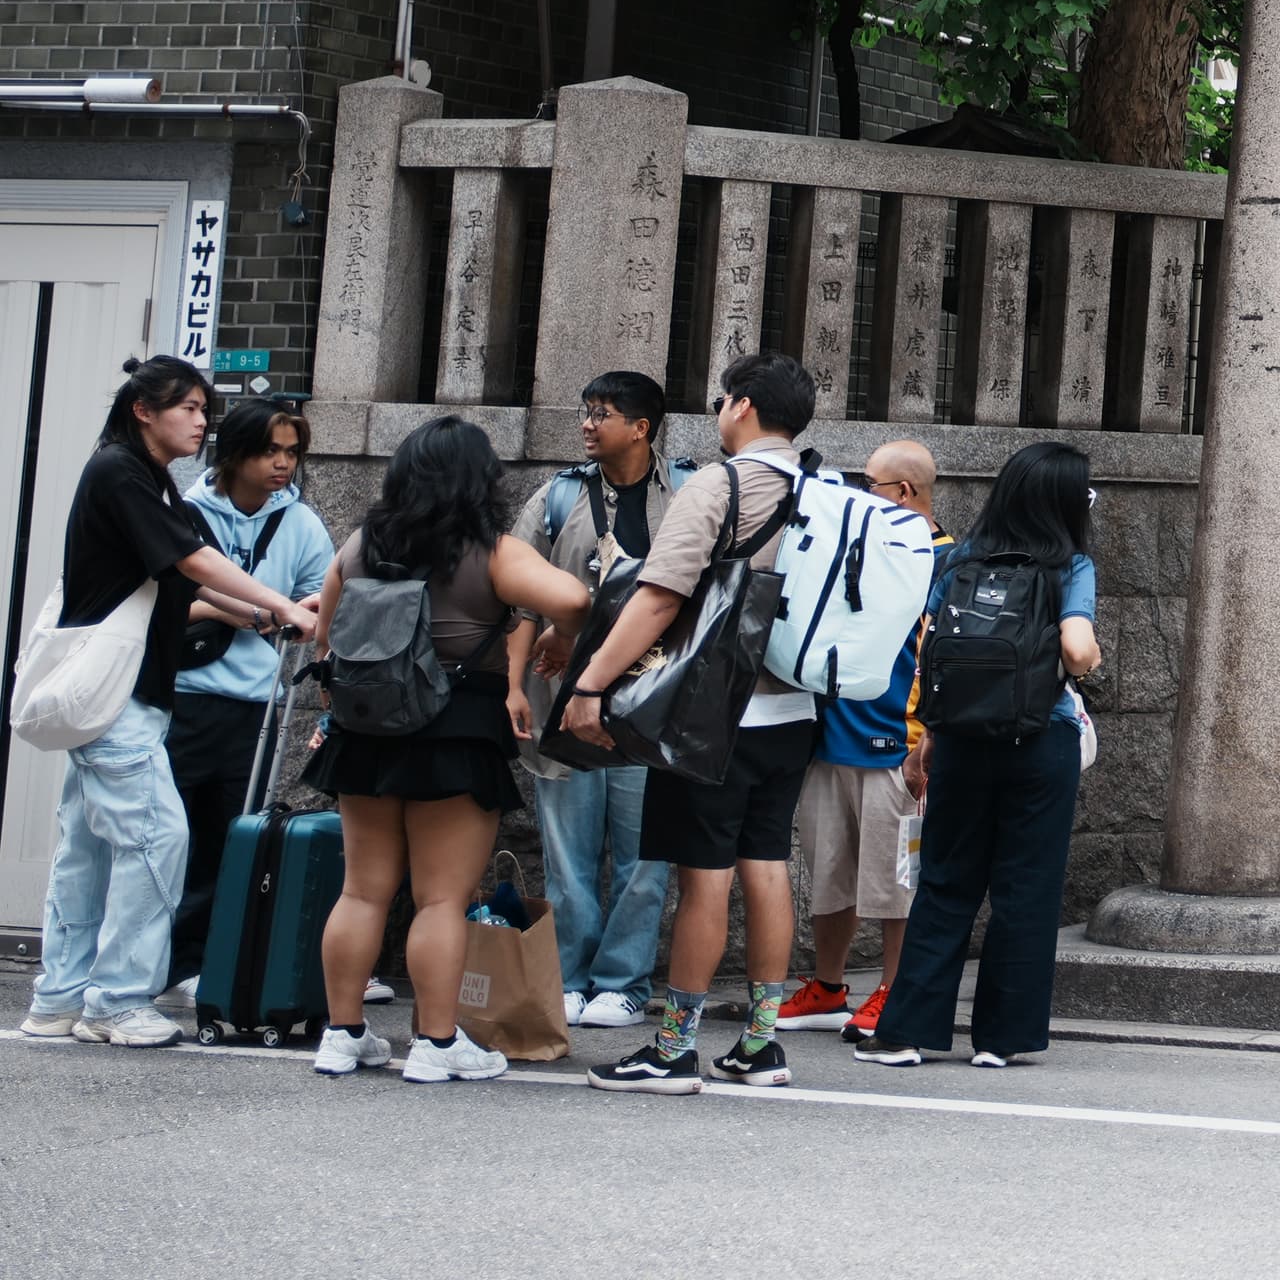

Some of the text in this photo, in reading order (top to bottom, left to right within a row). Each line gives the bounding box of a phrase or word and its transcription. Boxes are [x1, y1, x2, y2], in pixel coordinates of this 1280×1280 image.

[183, 209, 219, 358] ヤサカビル
[240, 355, 261, 367] 9-5
[464, 976, 485, 990] UNI
[462, 989, 485, 1003] QLO
